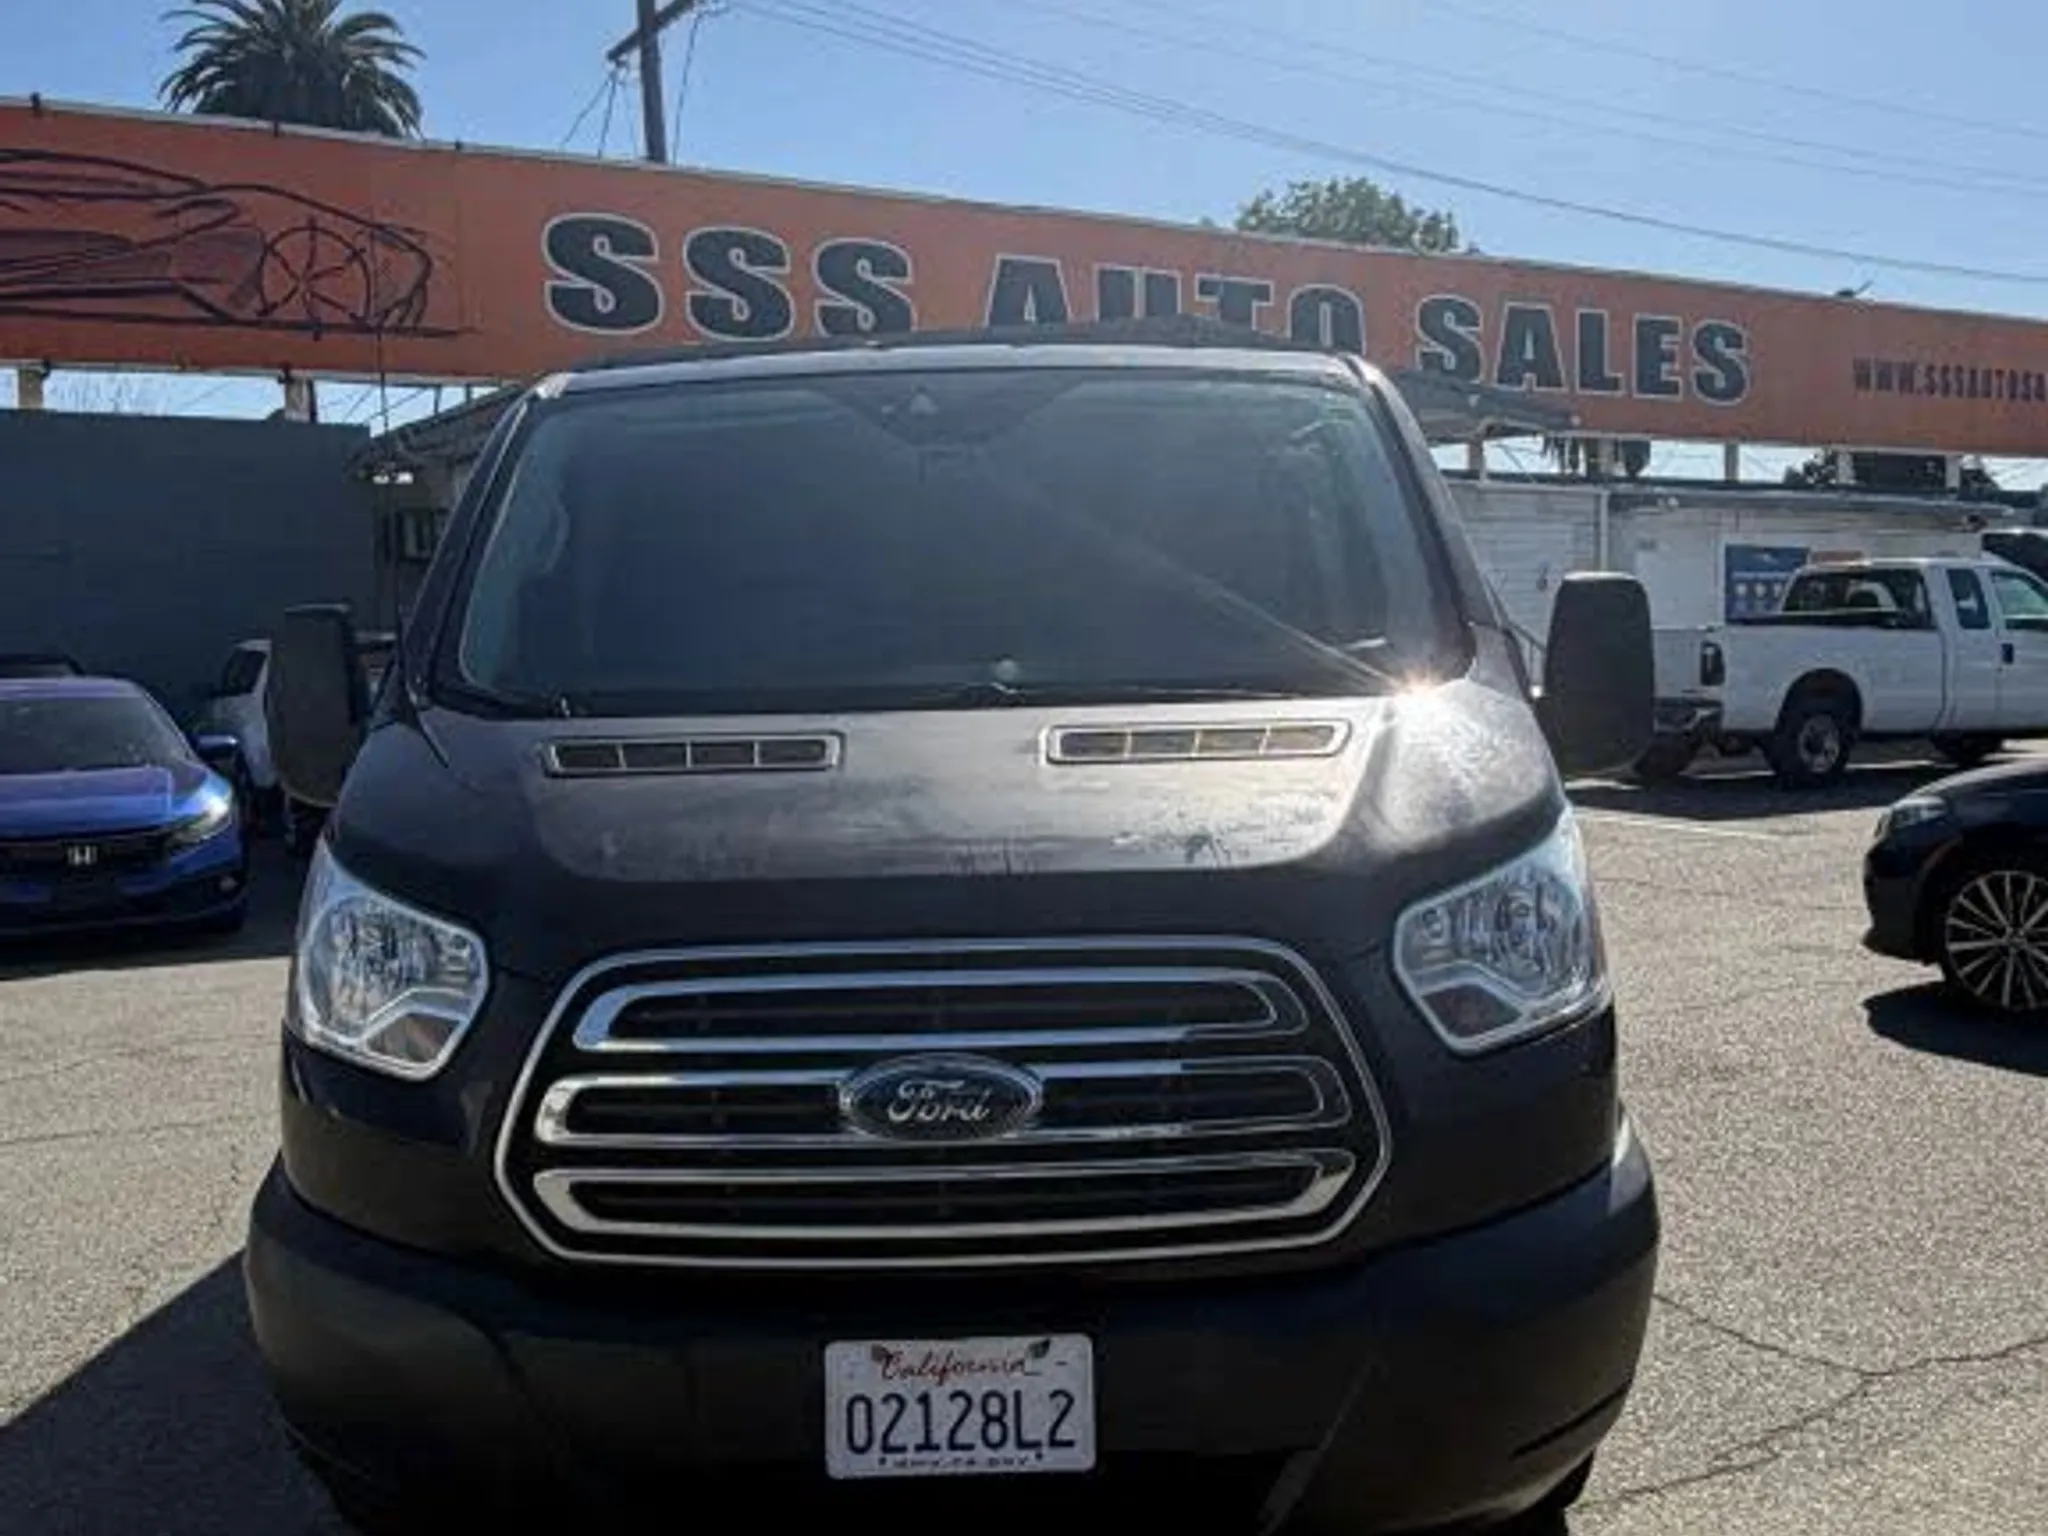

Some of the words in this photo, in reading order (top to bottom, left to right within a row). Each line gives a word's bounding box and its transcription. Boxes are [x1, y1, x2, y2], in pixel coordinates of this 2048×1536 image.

[541, 212, 920, 342] SSS
[984, 253, 1368, 355] AUTO
[1415, 293, 1750, 407] SALES
[886, 1079, 991, 1122] Ford
[881, 1350, 1027, 1387] California
[846, 1389, 1076, 1455] 02128L2
